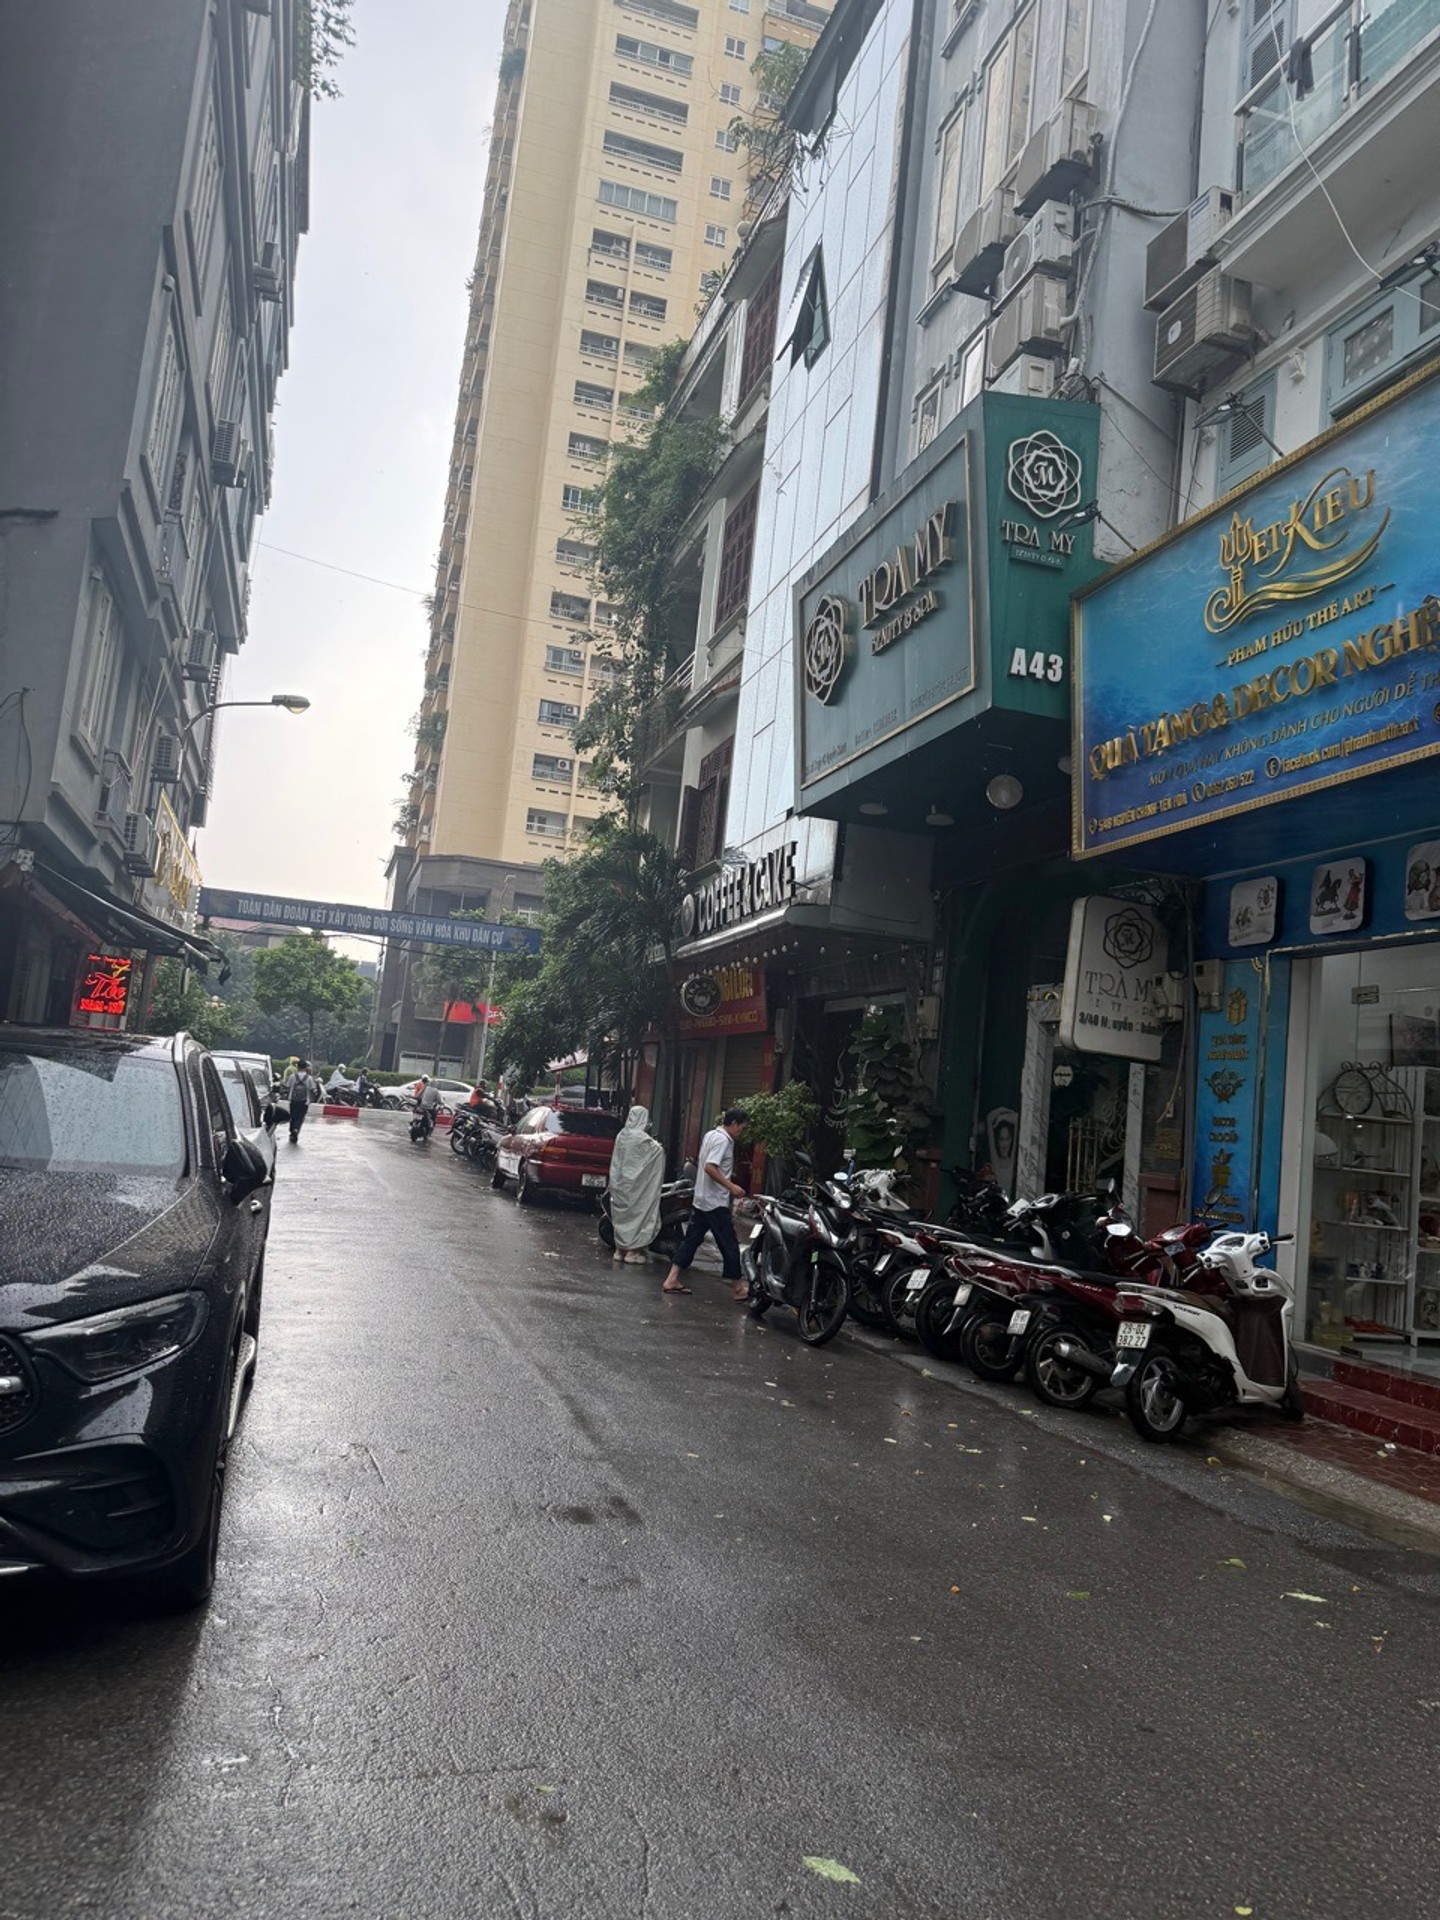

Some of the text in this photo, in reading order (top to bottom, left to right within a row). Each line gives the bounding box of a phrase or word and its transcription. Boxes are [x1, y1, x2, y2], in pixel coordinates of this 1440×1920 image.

[912, 500, 957, 586] MY
[1001, 519, 1078, 555] TRA MY
[1341, 588, 1375, 616] ART
[1010, 646, 1064, 683] A43
[1232, 648, 1338, 720] DECOR
[1311, 705, 1341, 730] CHO
[698, 866, 743, 934] COFFEE
[753, 841, 798, 913] CAKE
[237, 899, 261, 915] TOÀN
[262, 900, 282, 917] DÂN
[283, 903, 308, 921] ĐOÀN
[310, 905, 327, 923] KẾT
[328, 908, 346, 926] XÂY
[415, 920, 434, 937] VĂN
[453, 925, 471, 942] KHU
[472, 928, 489, 945] DÂN
[1084, 970, 1128, 999] TRÀ
[1101, 1016, 1134, 1032] Nuyễn
